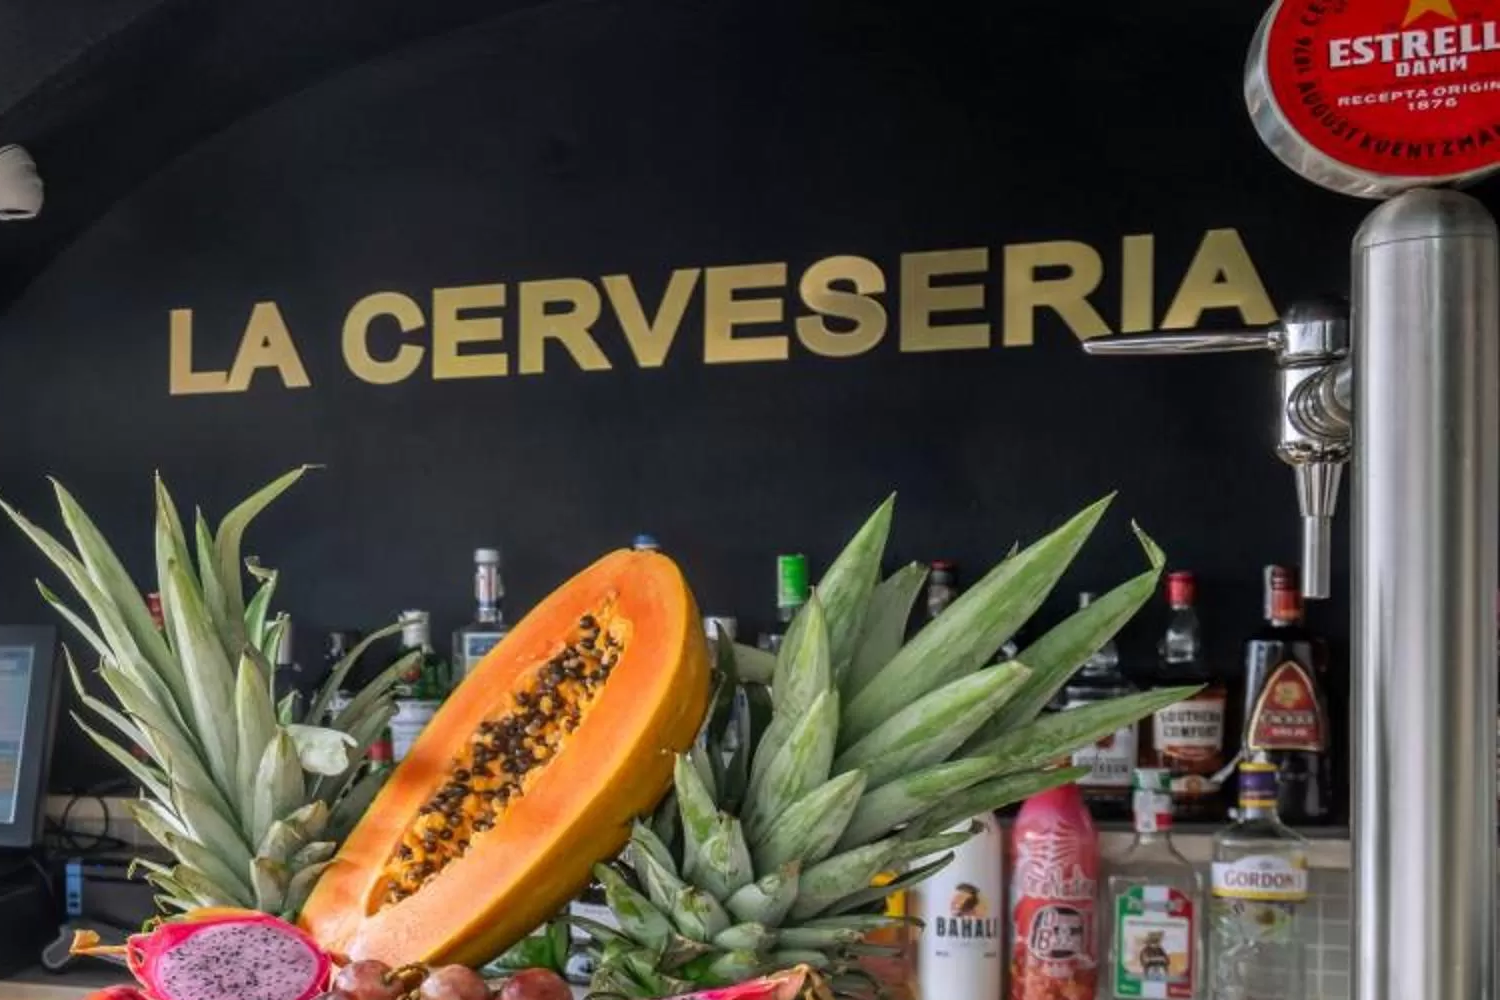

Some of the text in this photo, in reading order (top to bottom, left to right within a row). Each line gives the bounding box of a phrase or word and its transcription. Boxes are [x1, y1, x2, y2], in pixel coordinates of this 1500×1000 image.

[1395, 55, 1468, 77] DAMM
[1337, 89, 1429, 107] RECEPTA
[1407, 98, 1458, 111] 1876
[168, 227, 1279, 396] LA CERVESERIA
